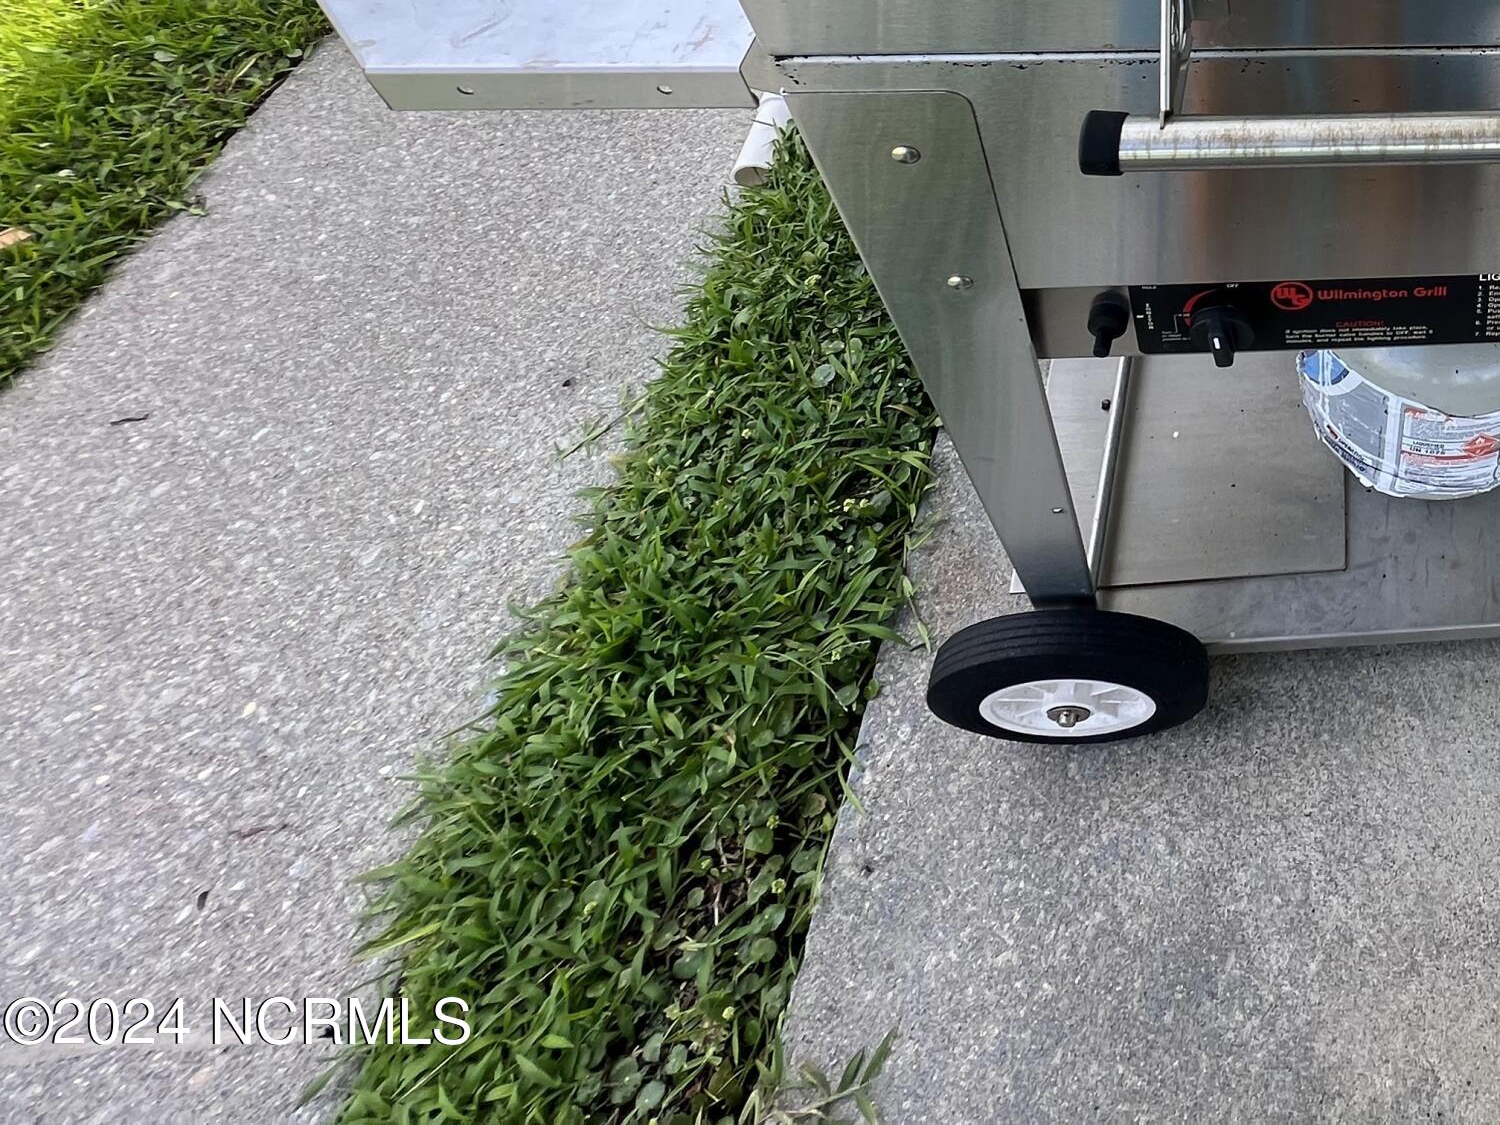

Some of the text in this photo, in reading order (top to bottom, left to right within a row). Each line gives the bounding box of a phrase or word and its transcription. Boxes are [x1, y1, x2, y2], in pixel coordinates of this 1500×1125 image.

[1317, 286, 1447, 301] Wilmington Grill
[1335, 320, 1385, 328] CAUTION!
